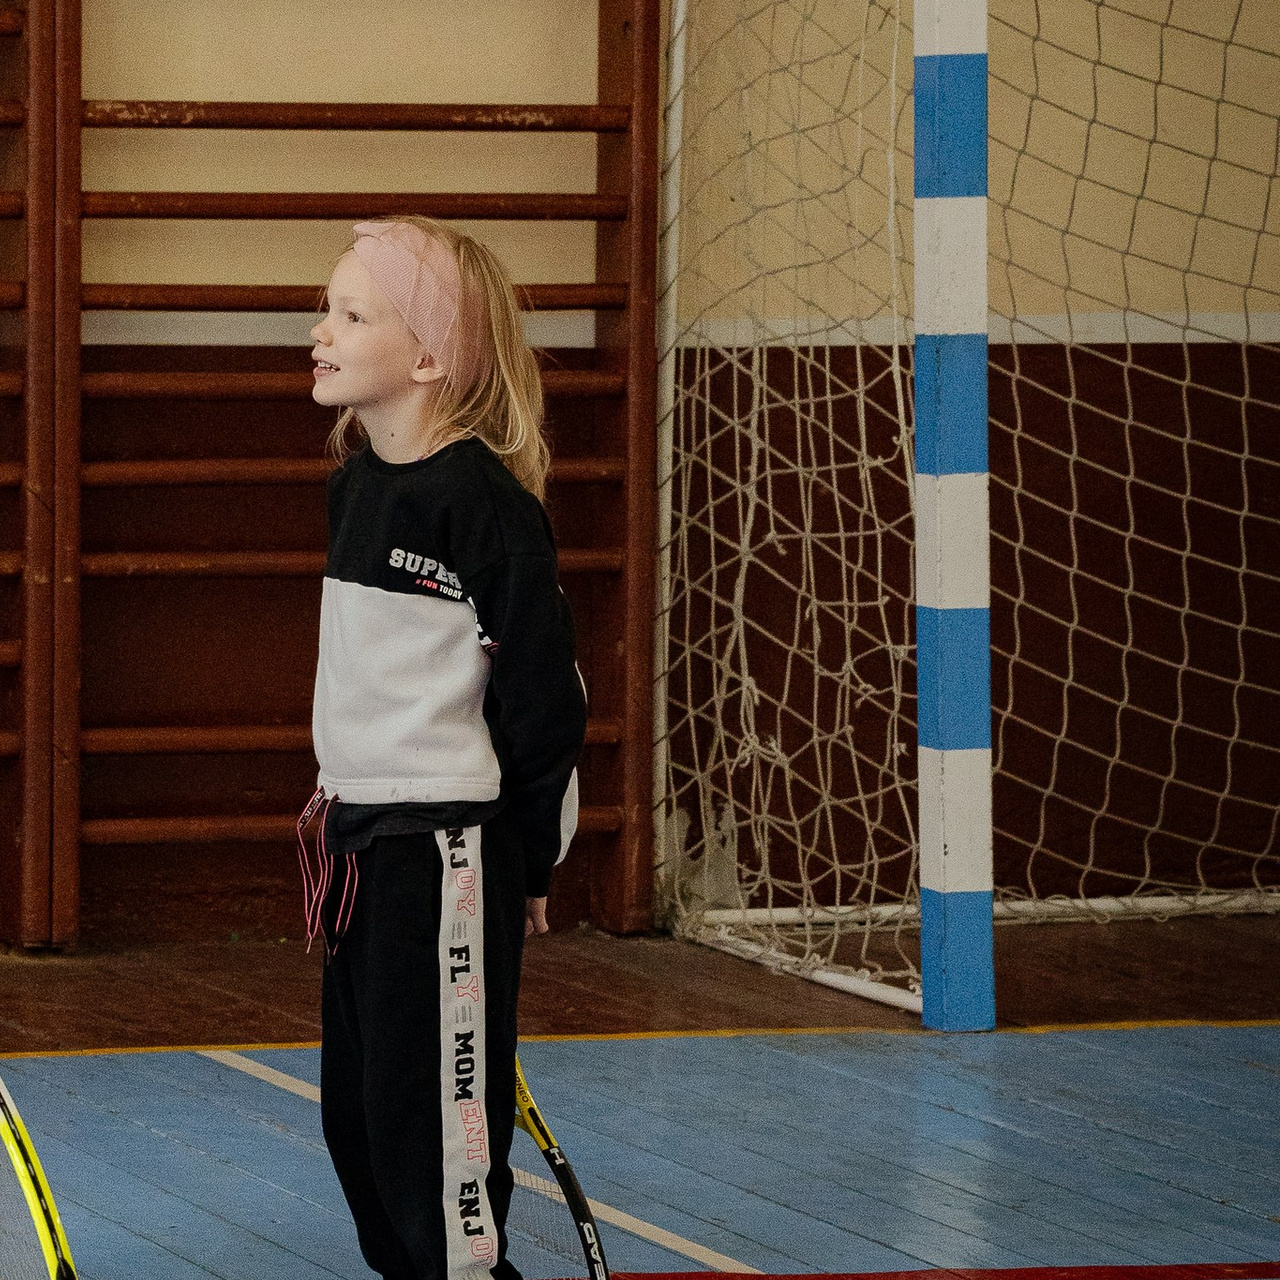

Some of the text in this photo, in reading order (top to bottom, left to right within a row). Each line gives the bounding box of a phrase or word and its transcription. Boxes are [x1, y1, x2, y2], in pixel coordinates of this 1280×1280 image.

[389, 548, 462, 589] SUPER
[439, 584, 463, 600] TODAY
[445, 827, 477, 916] NJOY
[449, 944, 480, 1002] FLY
[453, 1030, 487, 1163] MOMENT
